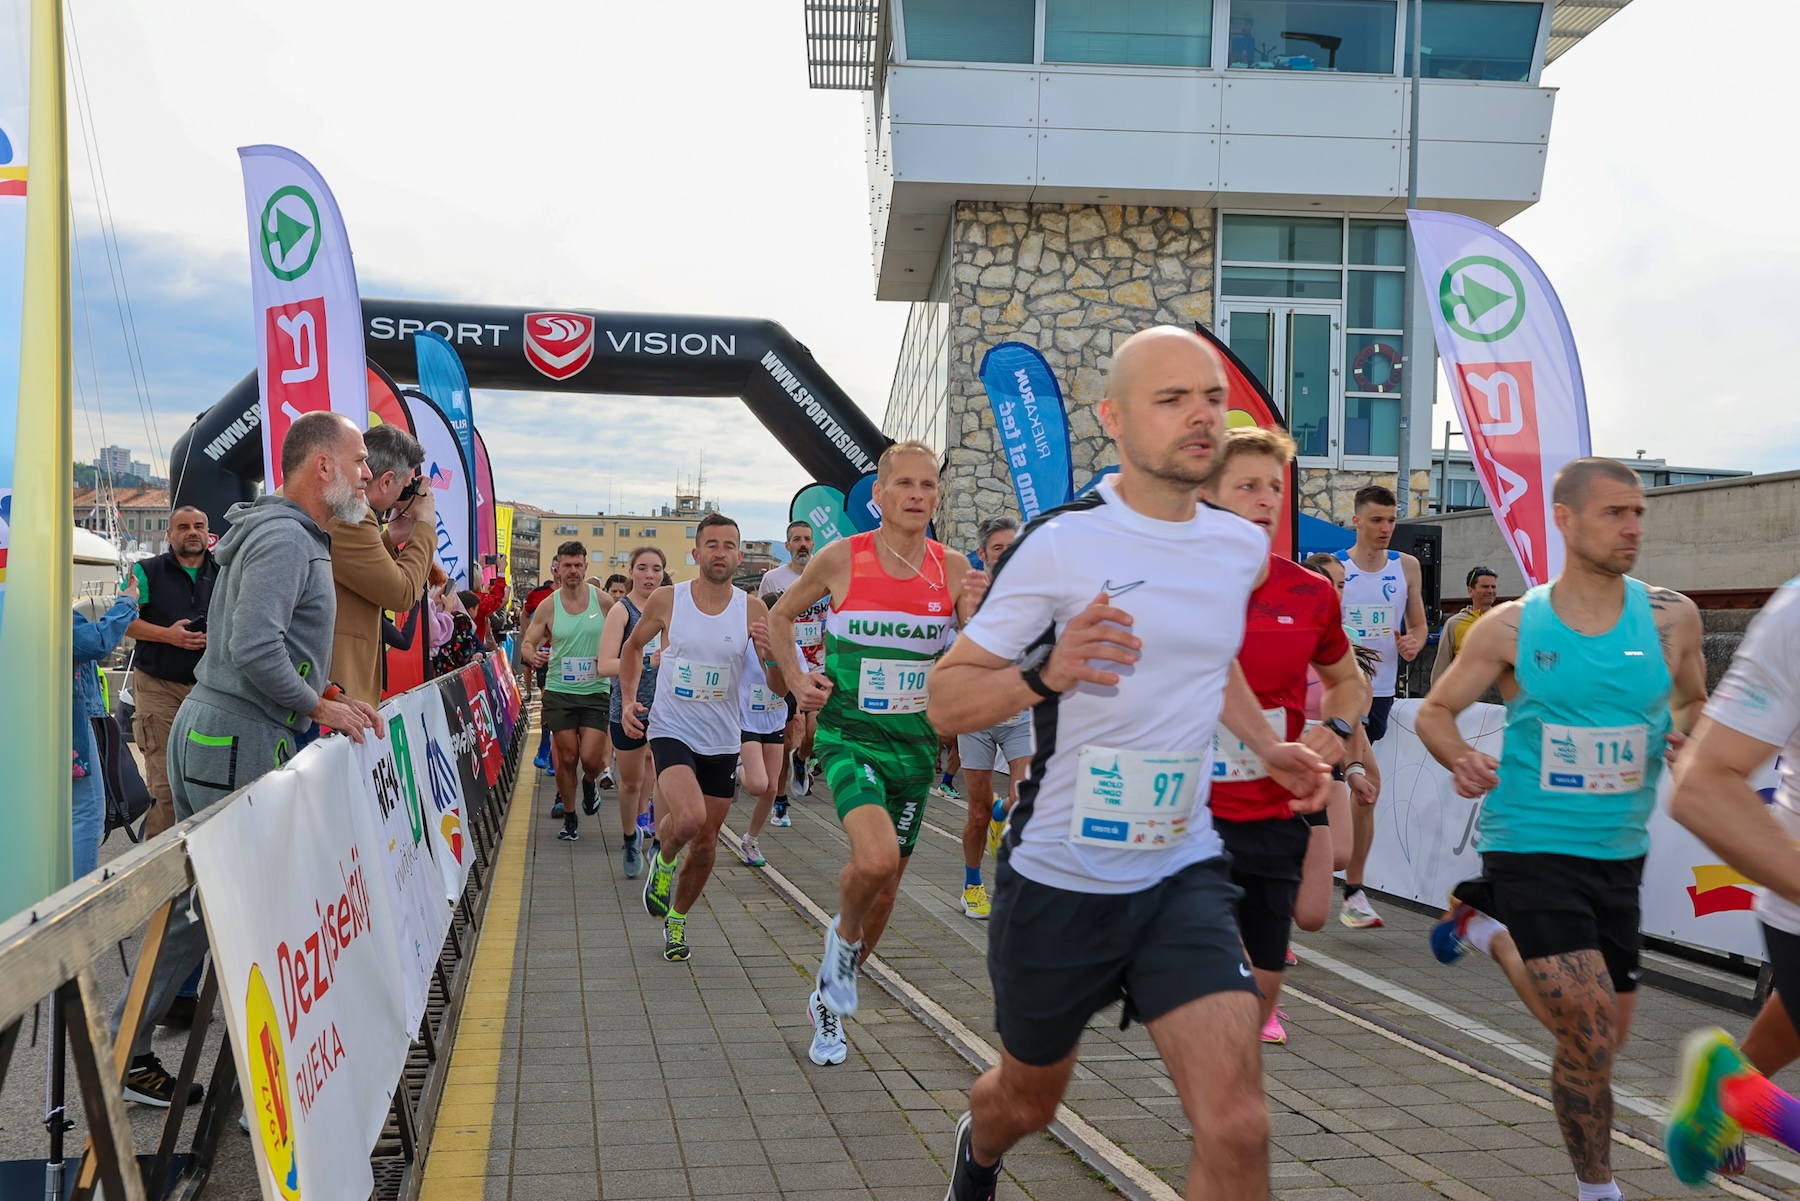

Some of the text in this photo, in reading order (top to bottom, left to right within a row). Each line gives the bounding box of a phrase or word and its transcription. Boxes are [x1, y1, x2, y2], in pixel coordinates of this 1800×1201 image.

[606, 330, 736, 356] VISION
[203, 399, 262, 462] WWW.SP
[1372, 611, 1386, 624] 81
[804, 627, 818, 636] 191
[849, 619, 946, 640] HUNGARY
[578, 662, 592, 672] 147
[705, 671, 720, 686] 10
[898, 671, 926, 691] 190
[1594, 739, 1635, 766] 114
[1092, 787, 1123, 798] LONGO
[1153, 772, 1185, 807] 97
[897, 801, 918, 832] HUN
[295, 1020, 346, 1123] RIJEKA
